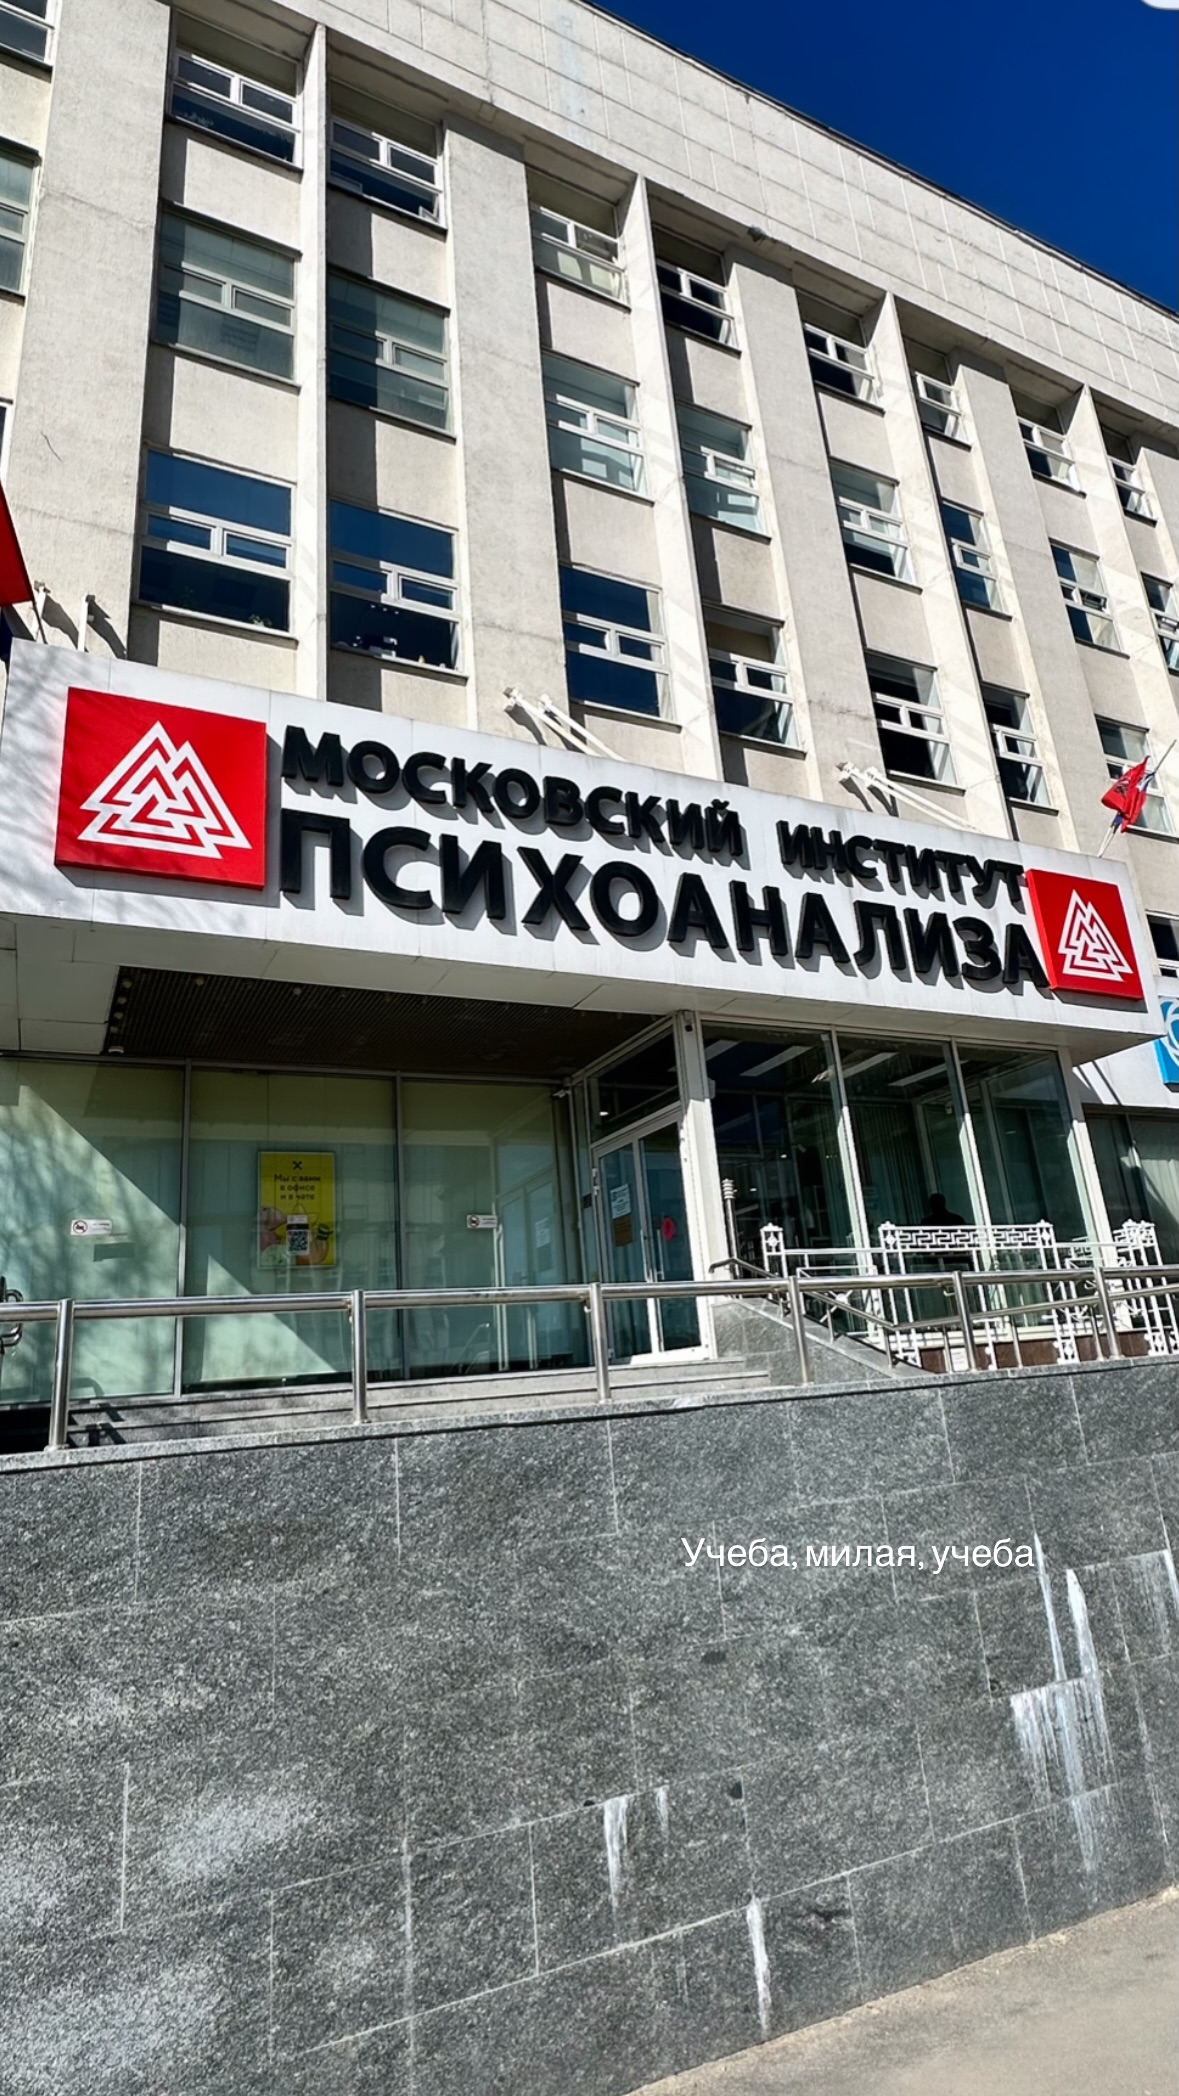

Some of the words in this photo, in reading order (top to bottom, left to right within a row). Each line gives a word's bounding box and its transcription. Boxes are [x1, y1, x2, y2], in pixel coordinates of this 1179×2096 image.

[281, 725, 744, 857] МОСКОВСКИЙ
[776, 820, 1025, 903] ИНСТИТУТ
[280, 808, 1050, 989] ПСИХОАНАЛИЗА
[274, 1173, 290, 1182] Мы
[287, 1184, 315, 1192] офисе
